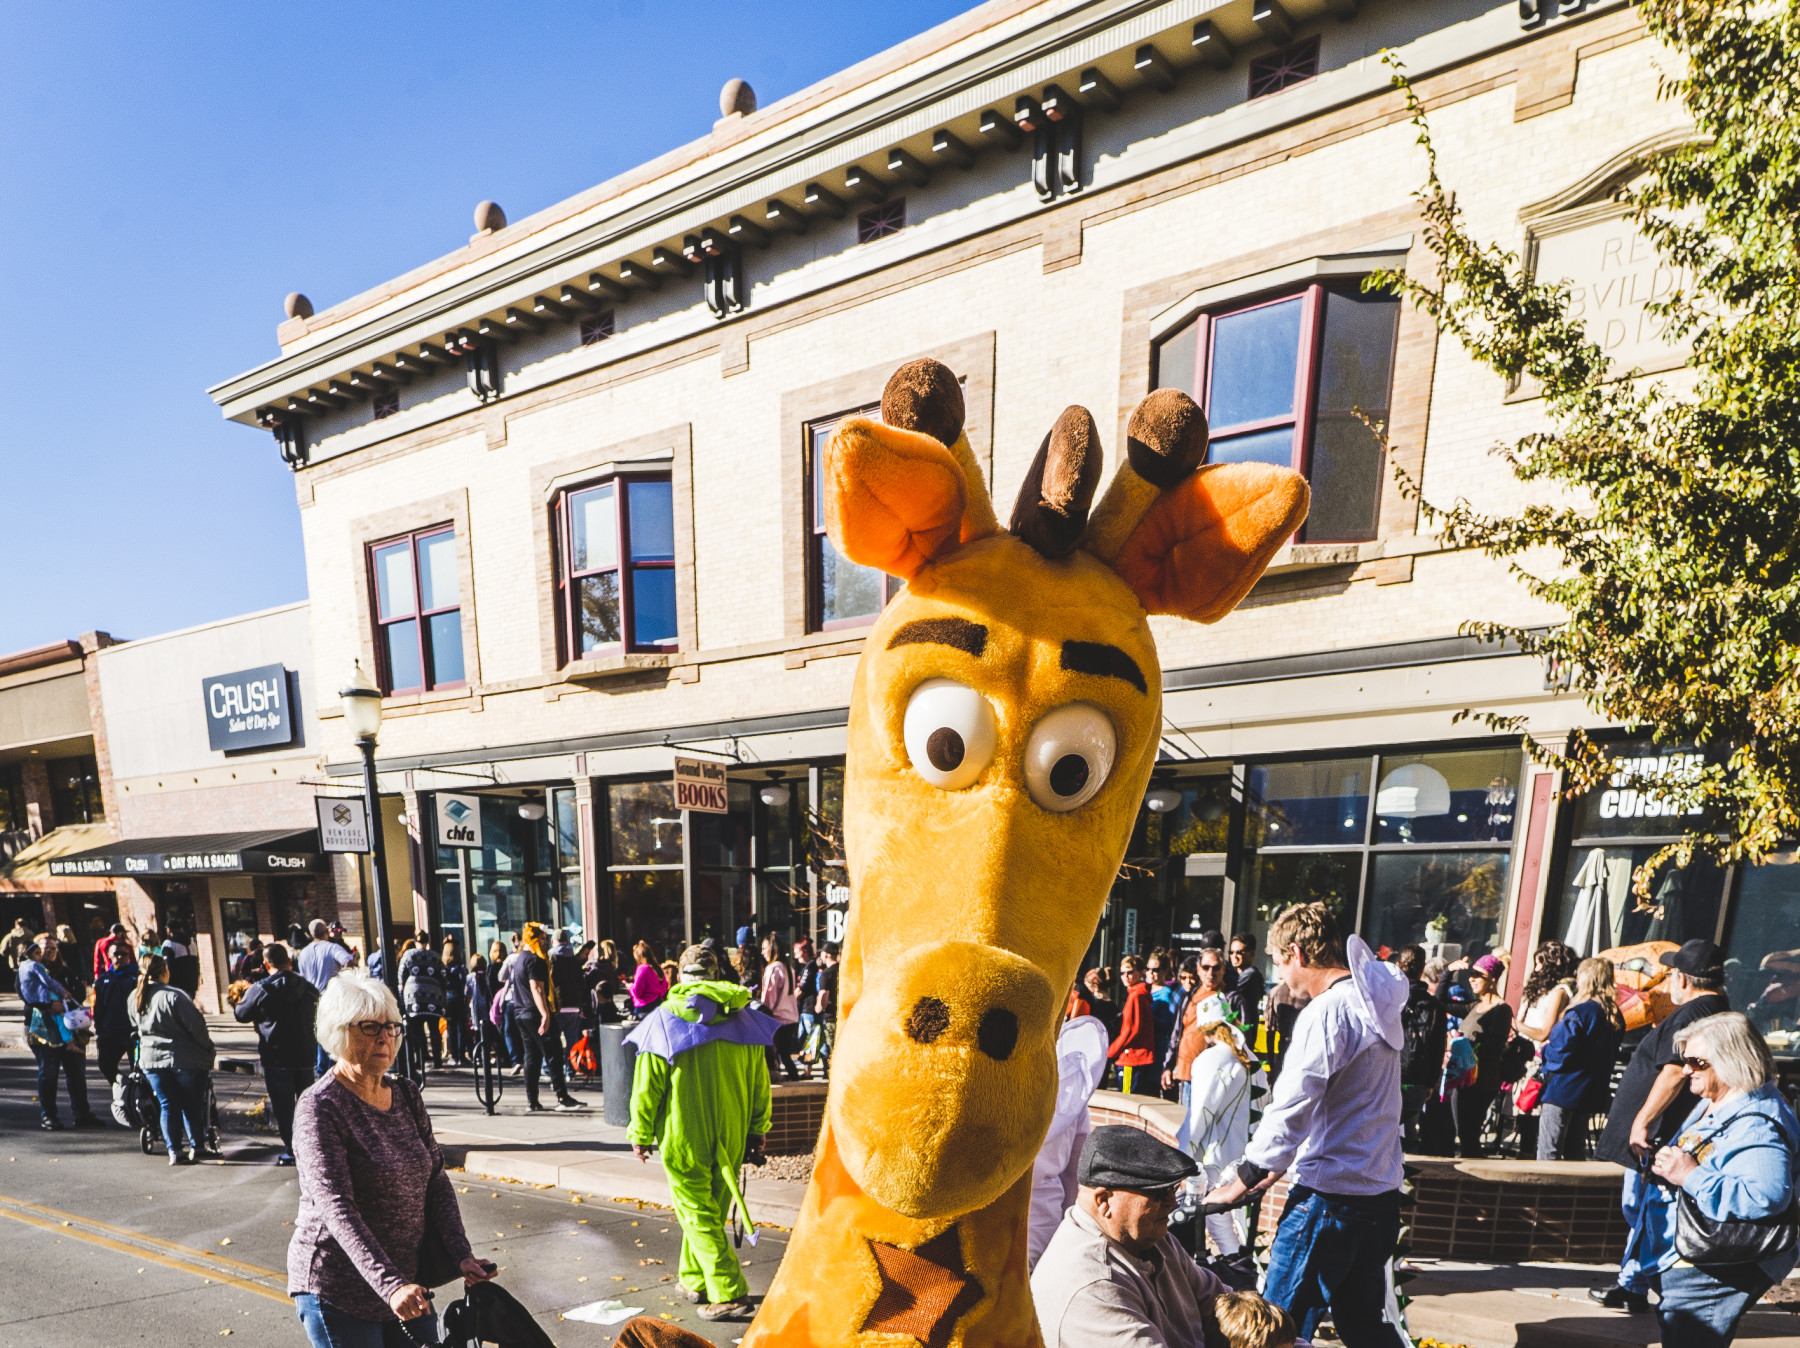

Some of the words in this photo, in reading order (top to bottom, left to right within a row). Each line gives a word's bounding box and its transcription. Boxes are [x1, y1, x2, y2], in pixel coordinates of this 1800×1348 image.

[1602, 232, 1650, 271] RE
[209, 677, 280, 719] CRUSH
[702, 763, 725, 784] Valley
[678, 782, 727, 810] BOOKS
[327, 829, 362, 837] VENTURE
[446, 825, 475, 842] chfa
[64, 861, 77, 873] SPA
[83, 860, 105, 873] SALON
[125, 857, 149, 872] CRUSH
[171, 857, 186, 869] DAY
[187, 855, 203, 869] SPA
[204, 855, 210, 868] &
[210, 853, 238, 867] SALON
[267, 854, 306, 868] CRUSH
